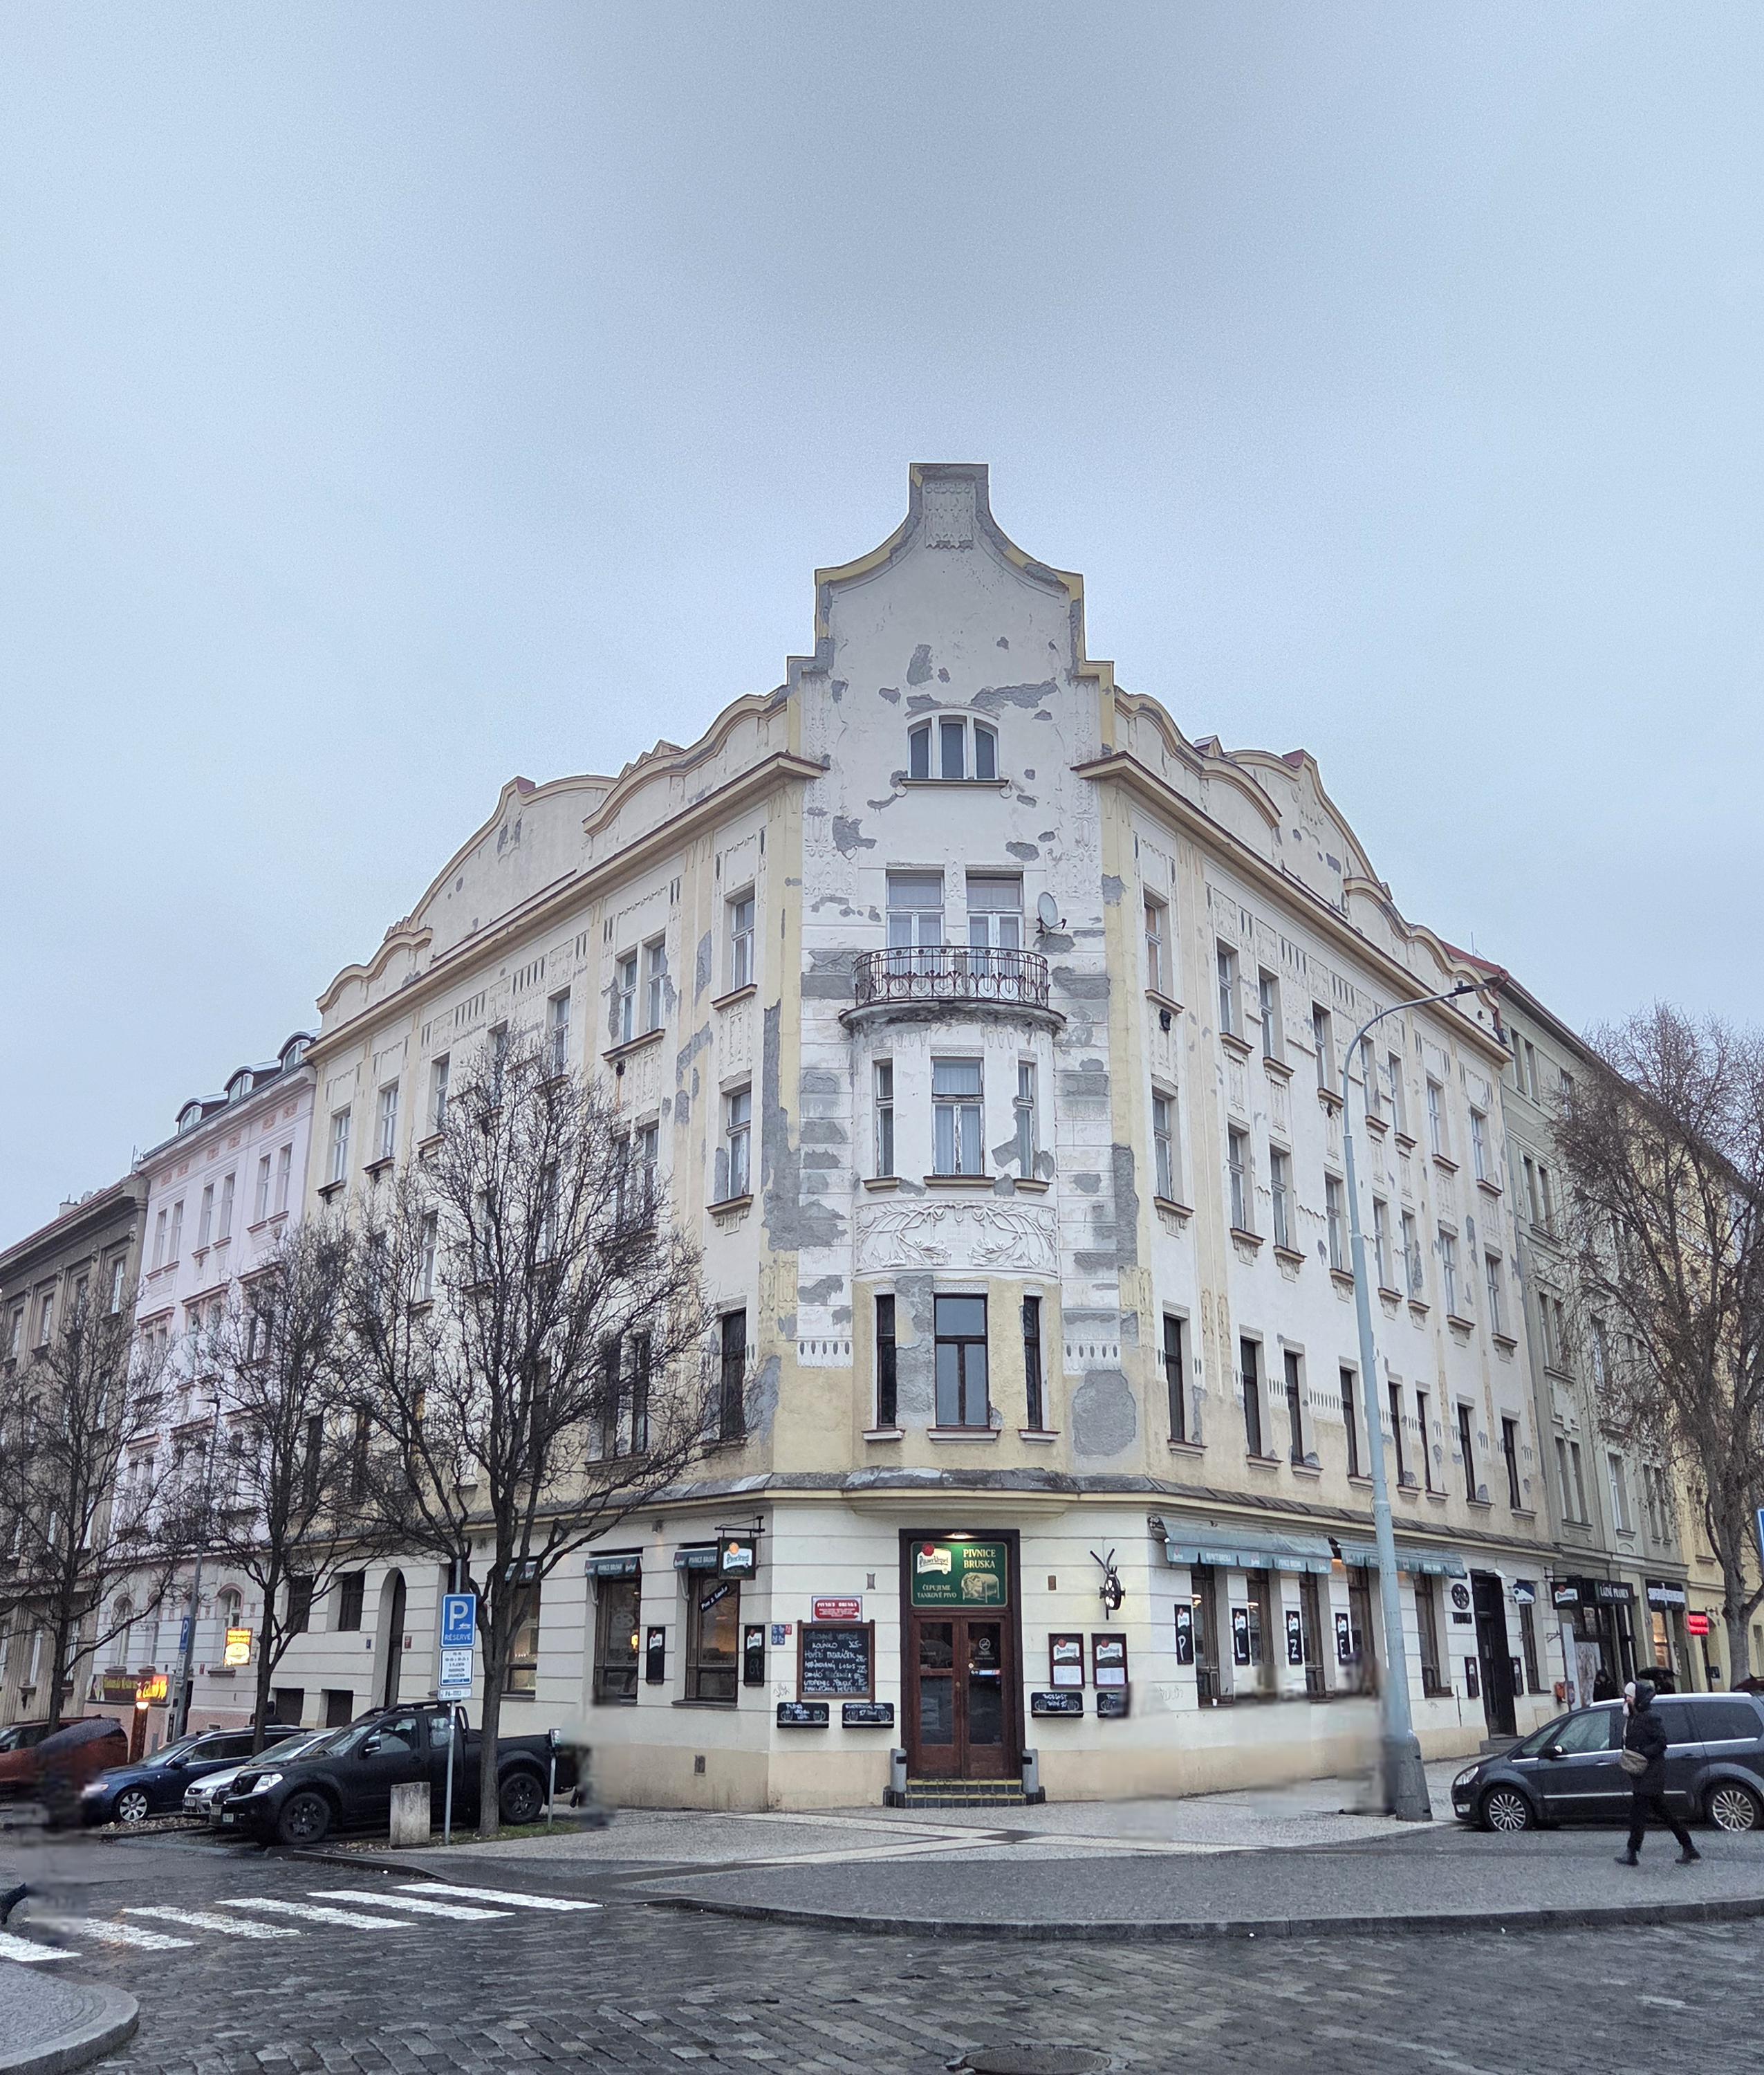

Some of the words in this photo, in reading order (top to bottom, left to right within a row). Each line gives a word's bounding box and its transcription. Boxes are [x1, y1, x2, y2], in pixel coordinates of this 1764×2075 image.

[963, 1549, 996, 1558] PIVNICE
[963, 1560, 996, 1569] BRUSKA
[922, 1583, 951, 1592] ČEPUJEME
[449, 1601, 468, 1630] P
[182, 1620, 189, 1641] P
[1178, 1635, 1186, 1661] P
[1236, 1636, 1246, 1658] L
